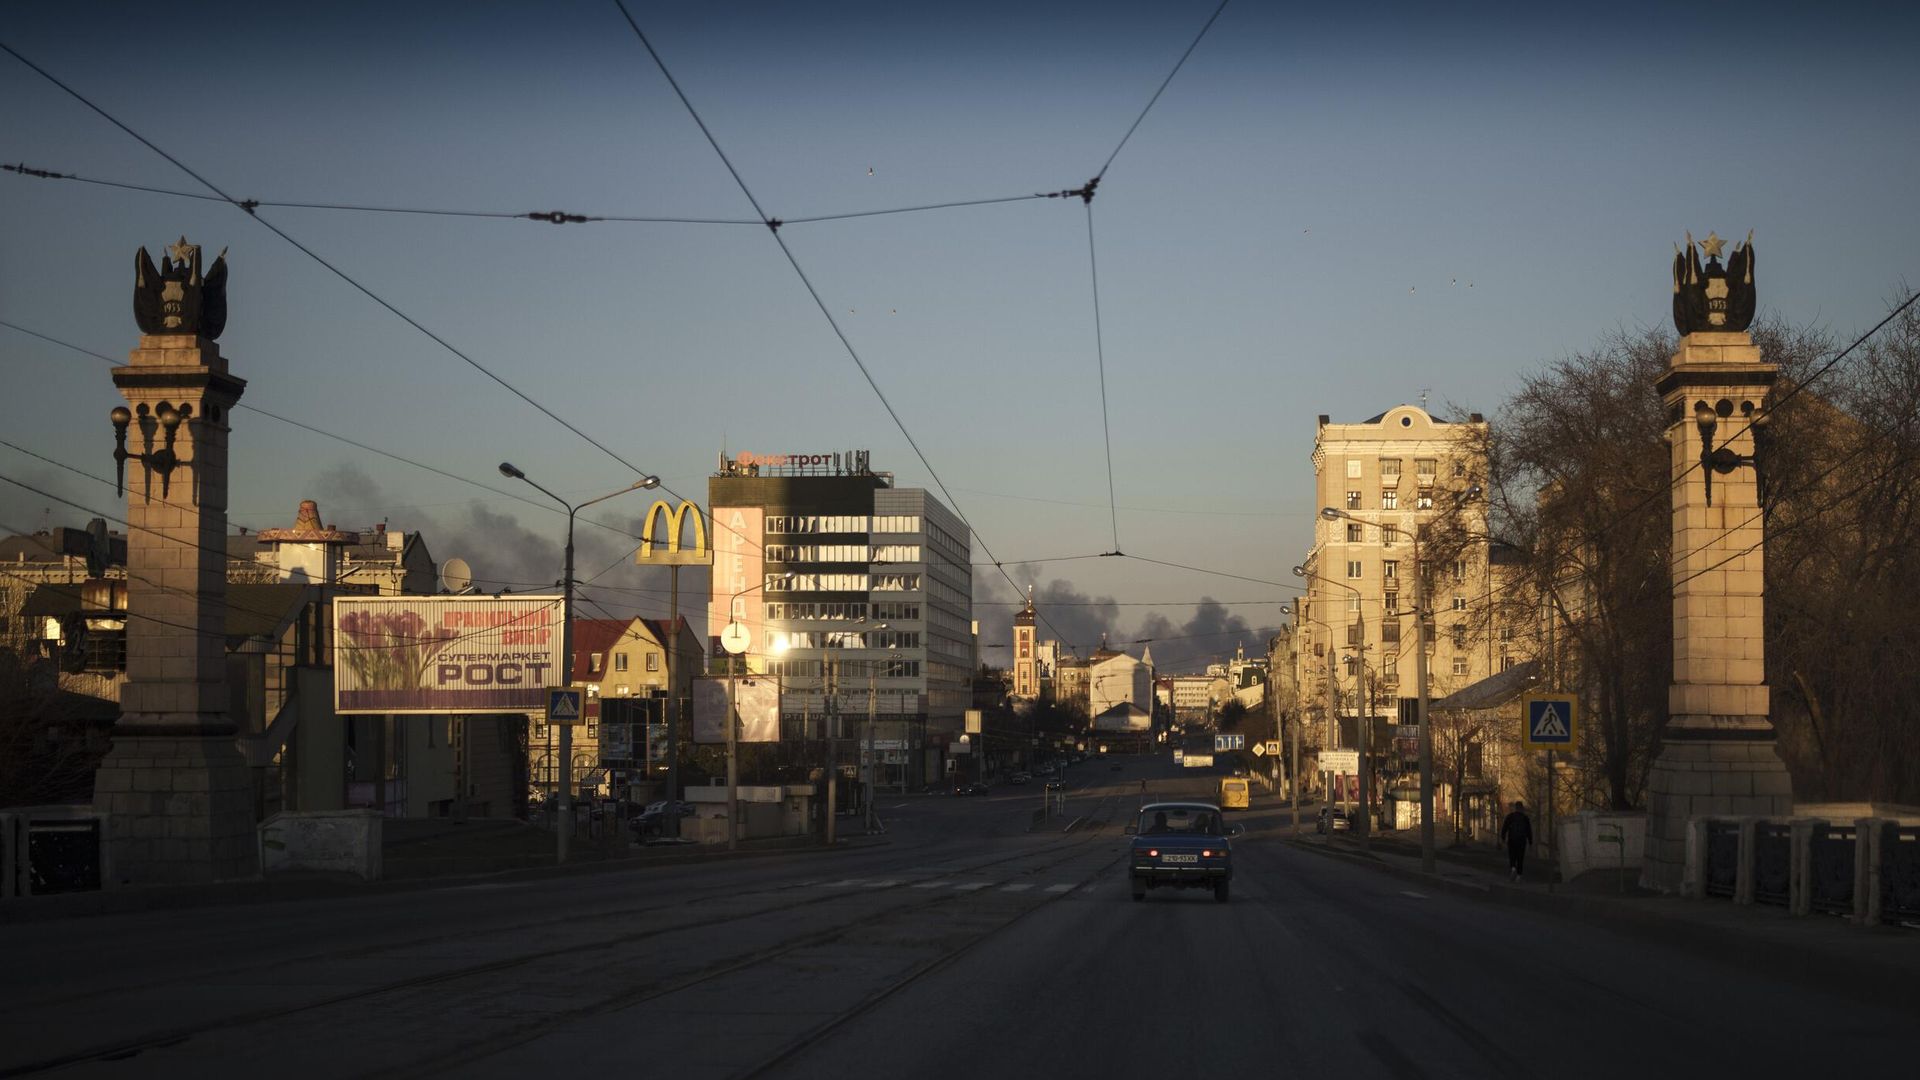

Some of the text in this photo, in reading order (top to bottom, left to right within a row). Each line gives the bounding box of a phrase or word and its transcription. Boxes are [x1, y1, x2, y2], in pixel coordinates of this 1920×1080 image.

[728, 511, 748, 621] АРЕНД
[437, 652, 551, 662] СУПЕРМАРКЕТ
[437, 663, 552, 686] РОСТ
